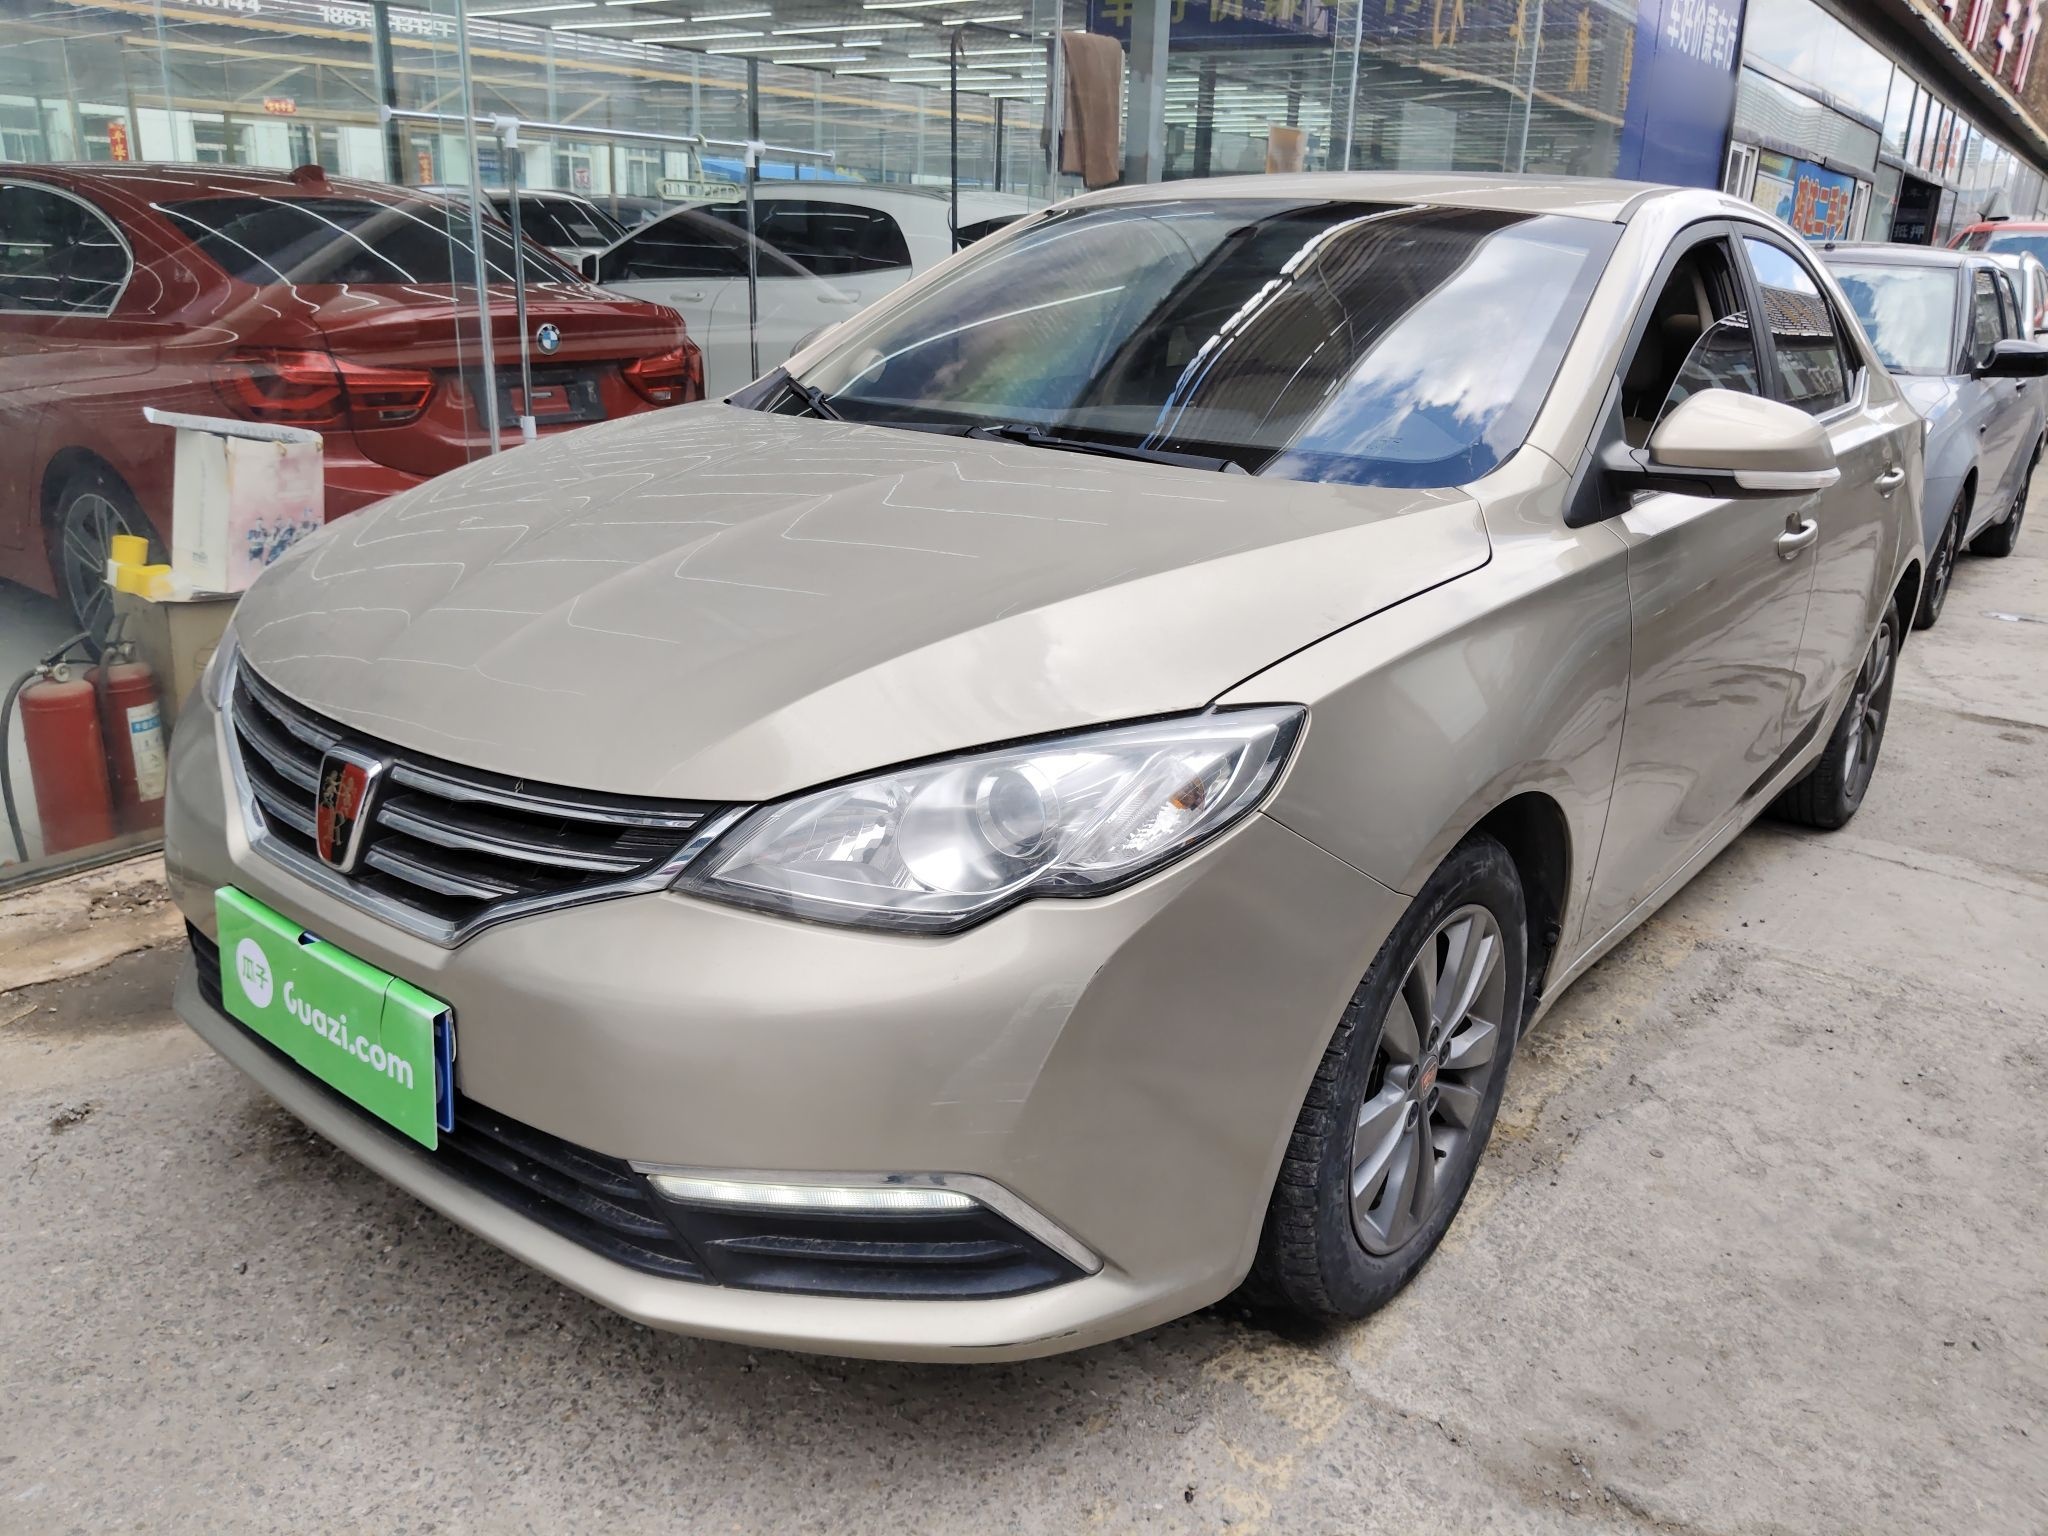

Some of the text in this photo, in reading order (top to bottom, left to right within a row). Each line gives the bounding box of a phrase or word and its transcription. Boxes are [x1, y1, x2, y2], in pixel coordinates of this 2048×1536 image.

[1667, 0, 1738, 72] 车好价廉车行
[242, 955, 268, 990] 瓜子
[283, 981, 414, 1090] Guazi.com
